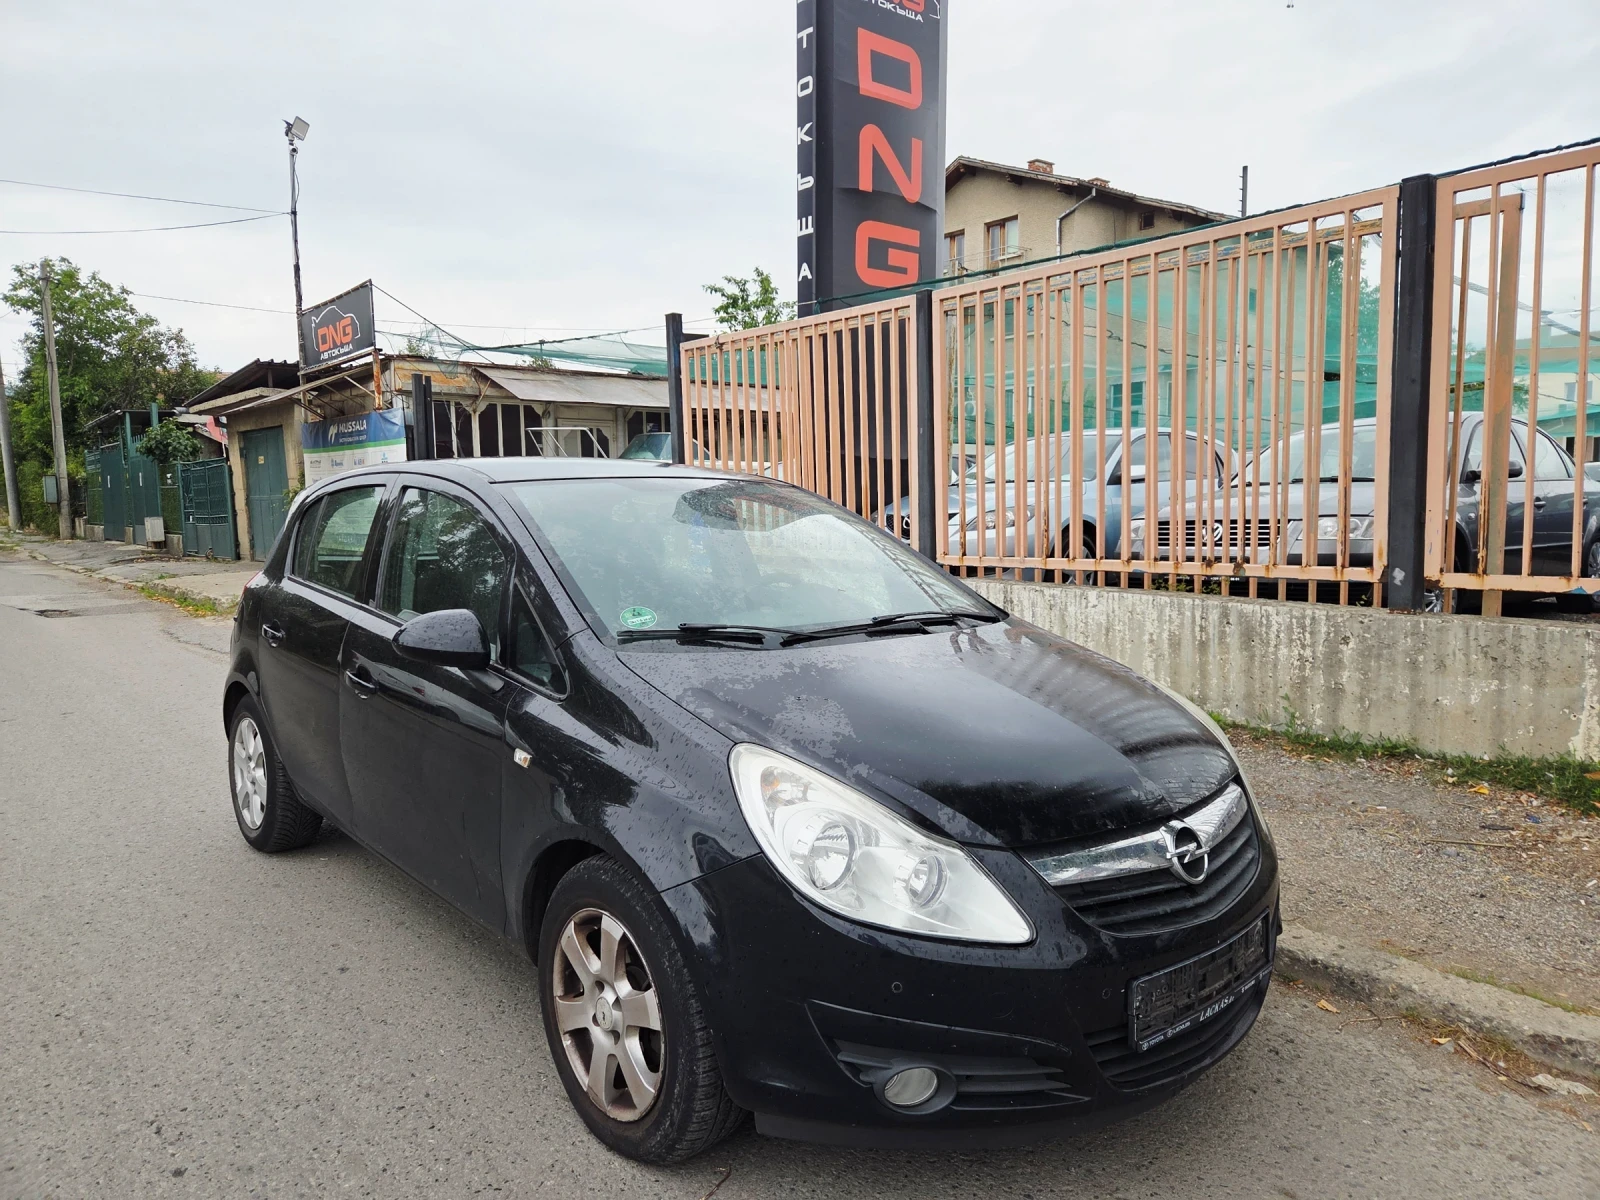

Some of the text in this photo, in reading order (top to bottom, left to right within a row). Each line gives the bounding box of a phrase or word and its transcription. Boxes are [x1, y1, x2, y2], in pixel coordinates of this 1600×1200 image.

[797, 0, 815, 282] ТОКЪЩА
[855, 27, 923, 290] DNG
[317, 316, 353, 353] DNG
[338, 419, 367, 434] MUSSALA
[1149, 1035, 1164, 1047] TOYOTA
